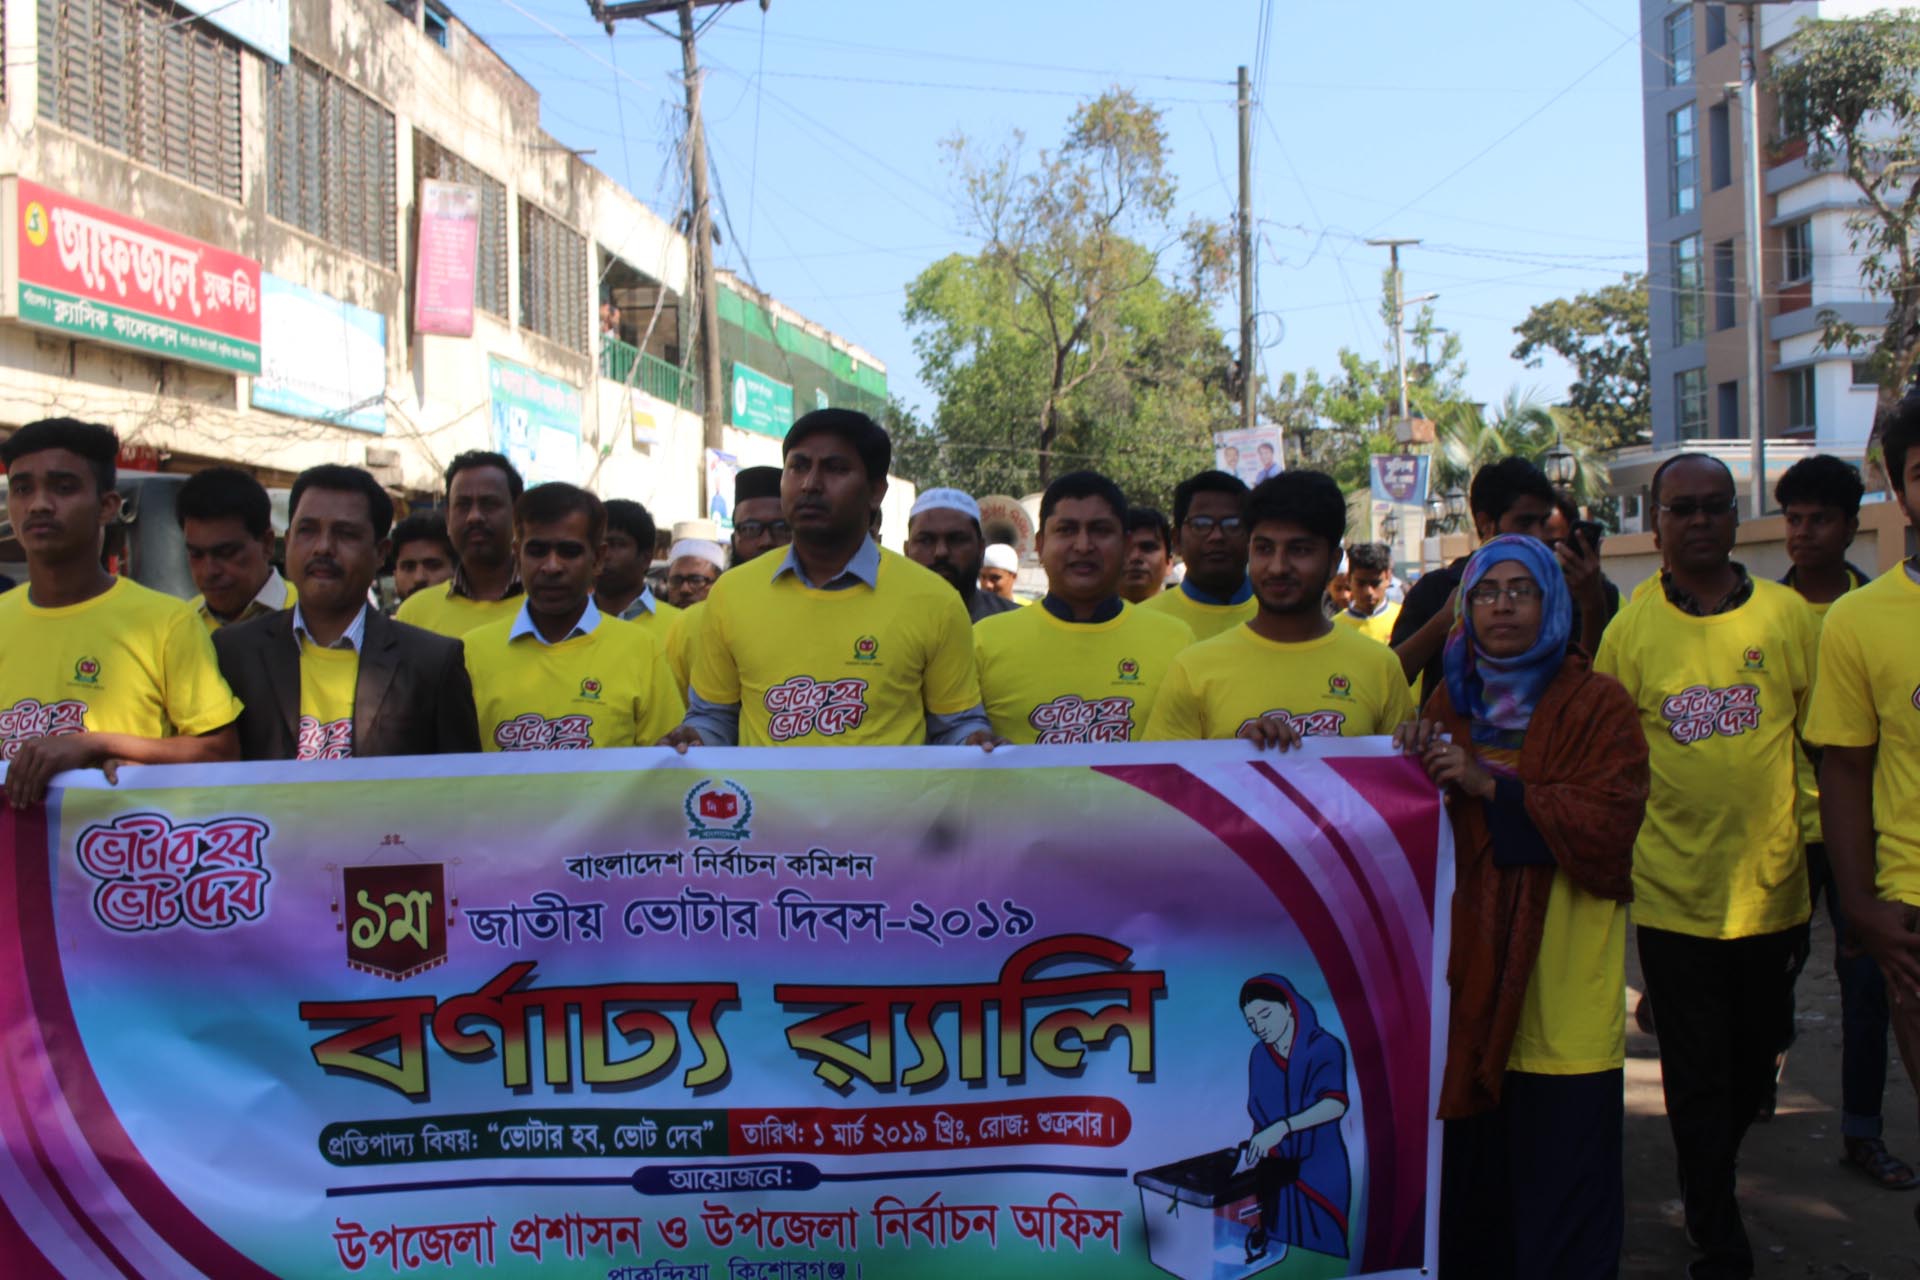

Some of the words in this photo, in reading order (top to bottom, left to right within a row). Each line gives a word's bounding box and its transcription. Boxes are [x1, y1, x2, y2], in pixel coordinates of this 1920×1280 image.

[51, 207, 202, 317] আফজাল
[55, 701, 87, 725] হব
[765, 678, 832, 711] ভোটার
[830, 680, 866, 702] হব
[1031, 696, 1098, 728] ভোটার
[1099, 699, 1133, 719] হব
[1663, 686, 1724, 719] ভোটার
[1725, 686, 1757, 706] হব
[495, 716, 558, 746] ভোটার
[559, 717, 591, 736] হব
[770, 706, 816, 740] ভোট
[817, 703, 866, 733] দেব
[1671, 712, 1716, 744] ভোট
[1717, 706, 1760, 734] দেব
[80, 816, 198, 876] ভোটার
[203, 822, 264, 867] হব
[566, 851, 683, 880] বাংলাদেশ
[691, 846, 777, 877] নির্বাচন
[784, 848, 874, 879] কমিশন
[100, 871, 182, 927] ভোট
[184, 869, 265, 924] দেব
[464, 892, 605, 946] জাতীয়
[624, 887, 760, 939] ভোটার
[772, 888, 1035, 947] দিবস-২০১৯
[351, 889, 433, 949] ১ম
[299, 960, 739, 1095] বর্ণাঢ্য
[328, 1128, 415, 1160] প্রতিপাদ্য
[420, 1122, 479, 1154] বিষয়:
[570, 1124, 605, 1156] হব,
[613, 1116, 657, 1150] ভোট
[740, 1115, 804, 1146] তারিখ:
[813, 1124, 824, 1147] ১
[831, 1113, 866, 1147] মার্চ
[872, 1119, 928, 1147] ২০১৯
[332, 1216, 496, 1271] উপজেলা
[509, 1212, 643, 1263] প্রশাসন
[658, 1216, 689, 1250] ও
[700, 1199, 861, 1250] উপজেলা
[870, 1191, 1000, 1248] নির্বাচন
[1009, 1192, 1123, 1252] অফিস
